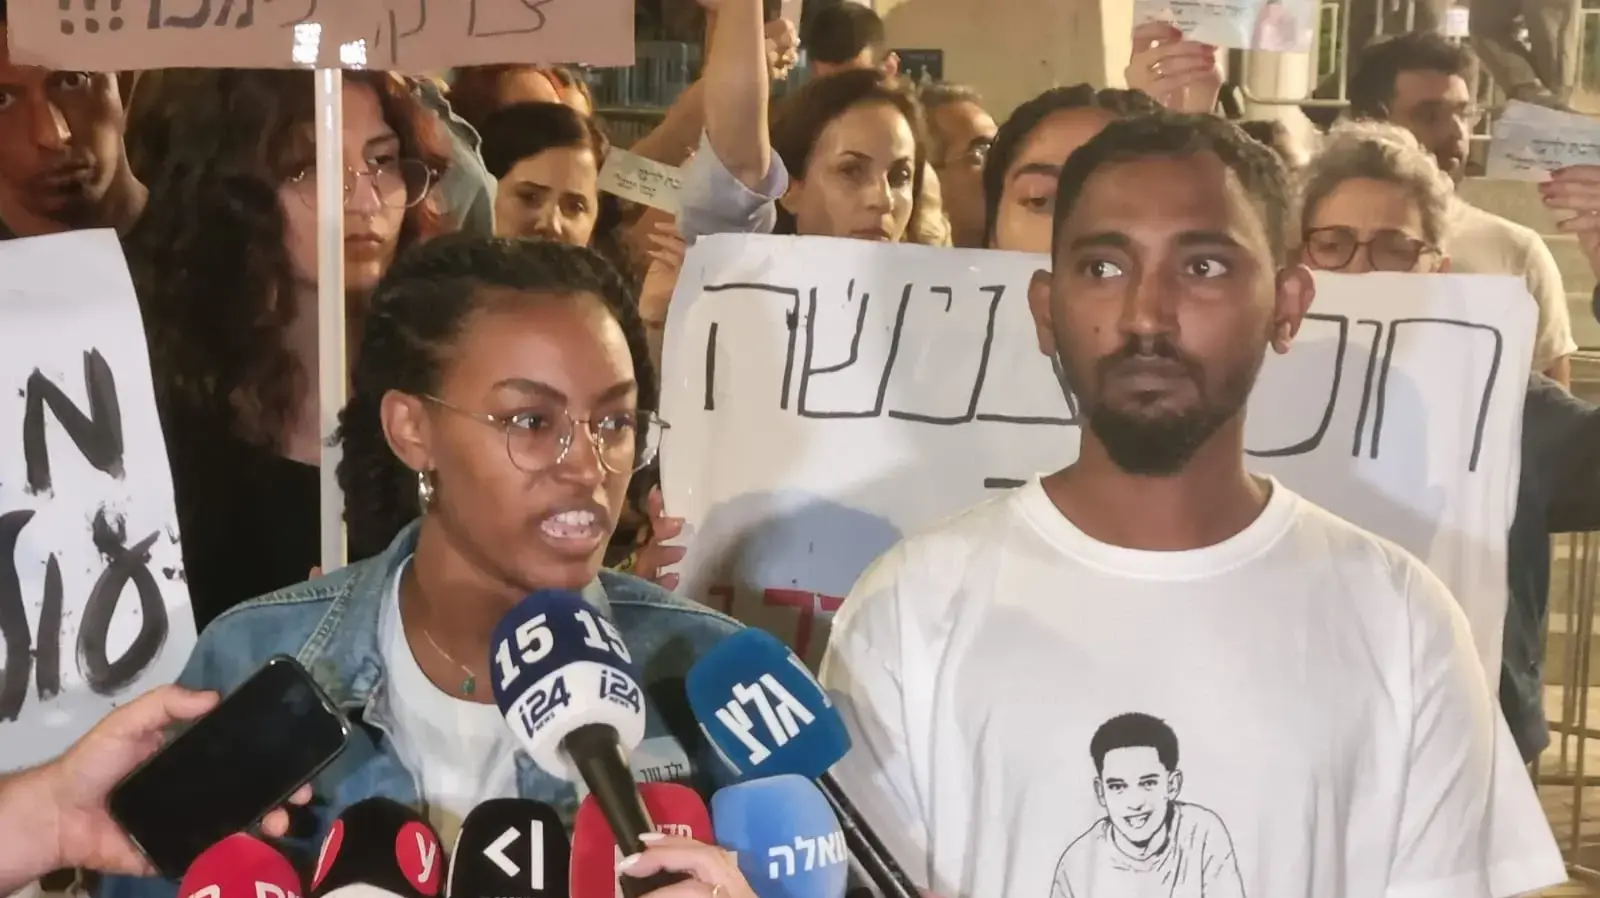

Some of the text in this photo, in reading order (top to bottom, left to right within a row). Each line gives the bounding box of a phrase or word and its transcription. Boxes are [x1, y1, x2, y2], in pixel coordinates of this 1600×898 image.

[495, 612, 555, 692] 15
[518, 674, 572, 740] i24
[599, 668, 641, 715] i24
